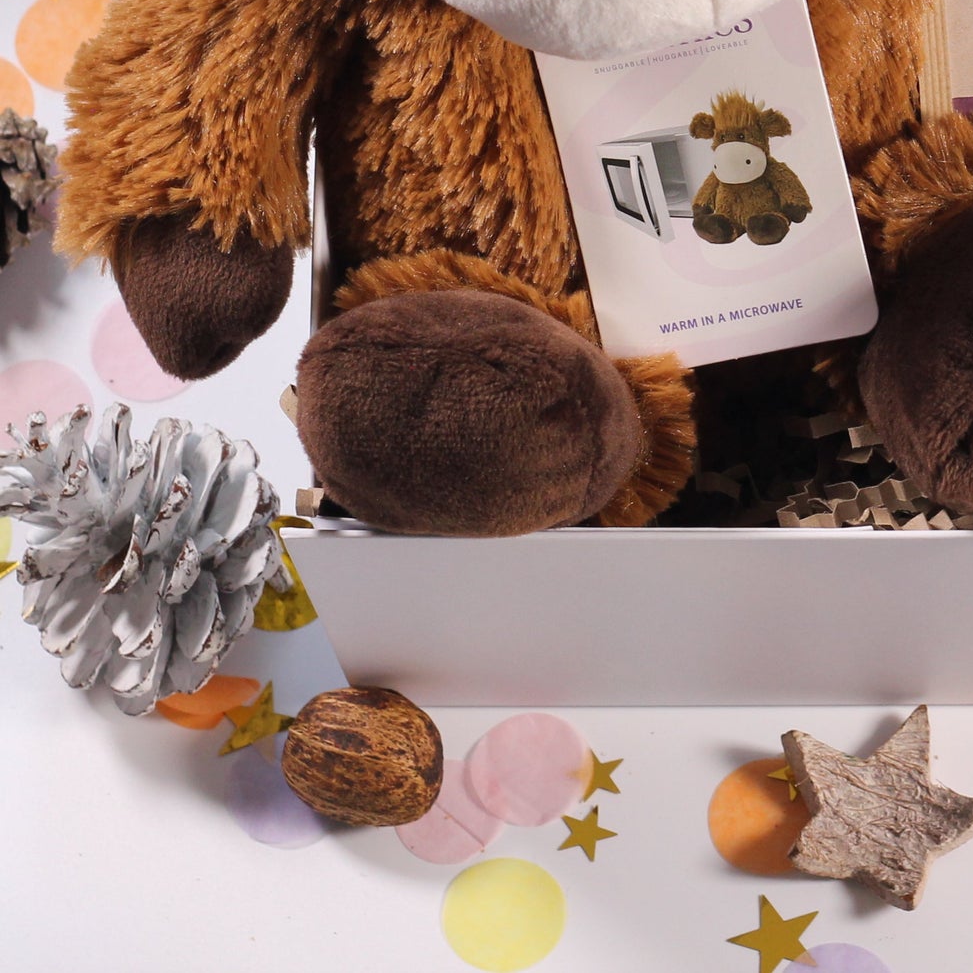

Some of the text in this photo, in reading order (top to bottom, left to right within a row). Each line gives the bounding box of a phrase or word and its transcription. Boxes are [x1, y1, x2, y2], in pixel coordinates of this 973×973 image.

[594, 39, 749, 74] SNUGGABLE HUGGABLE LOVEABLE
[659, 298, 804, 334] WARM IN A MICROWAVE
